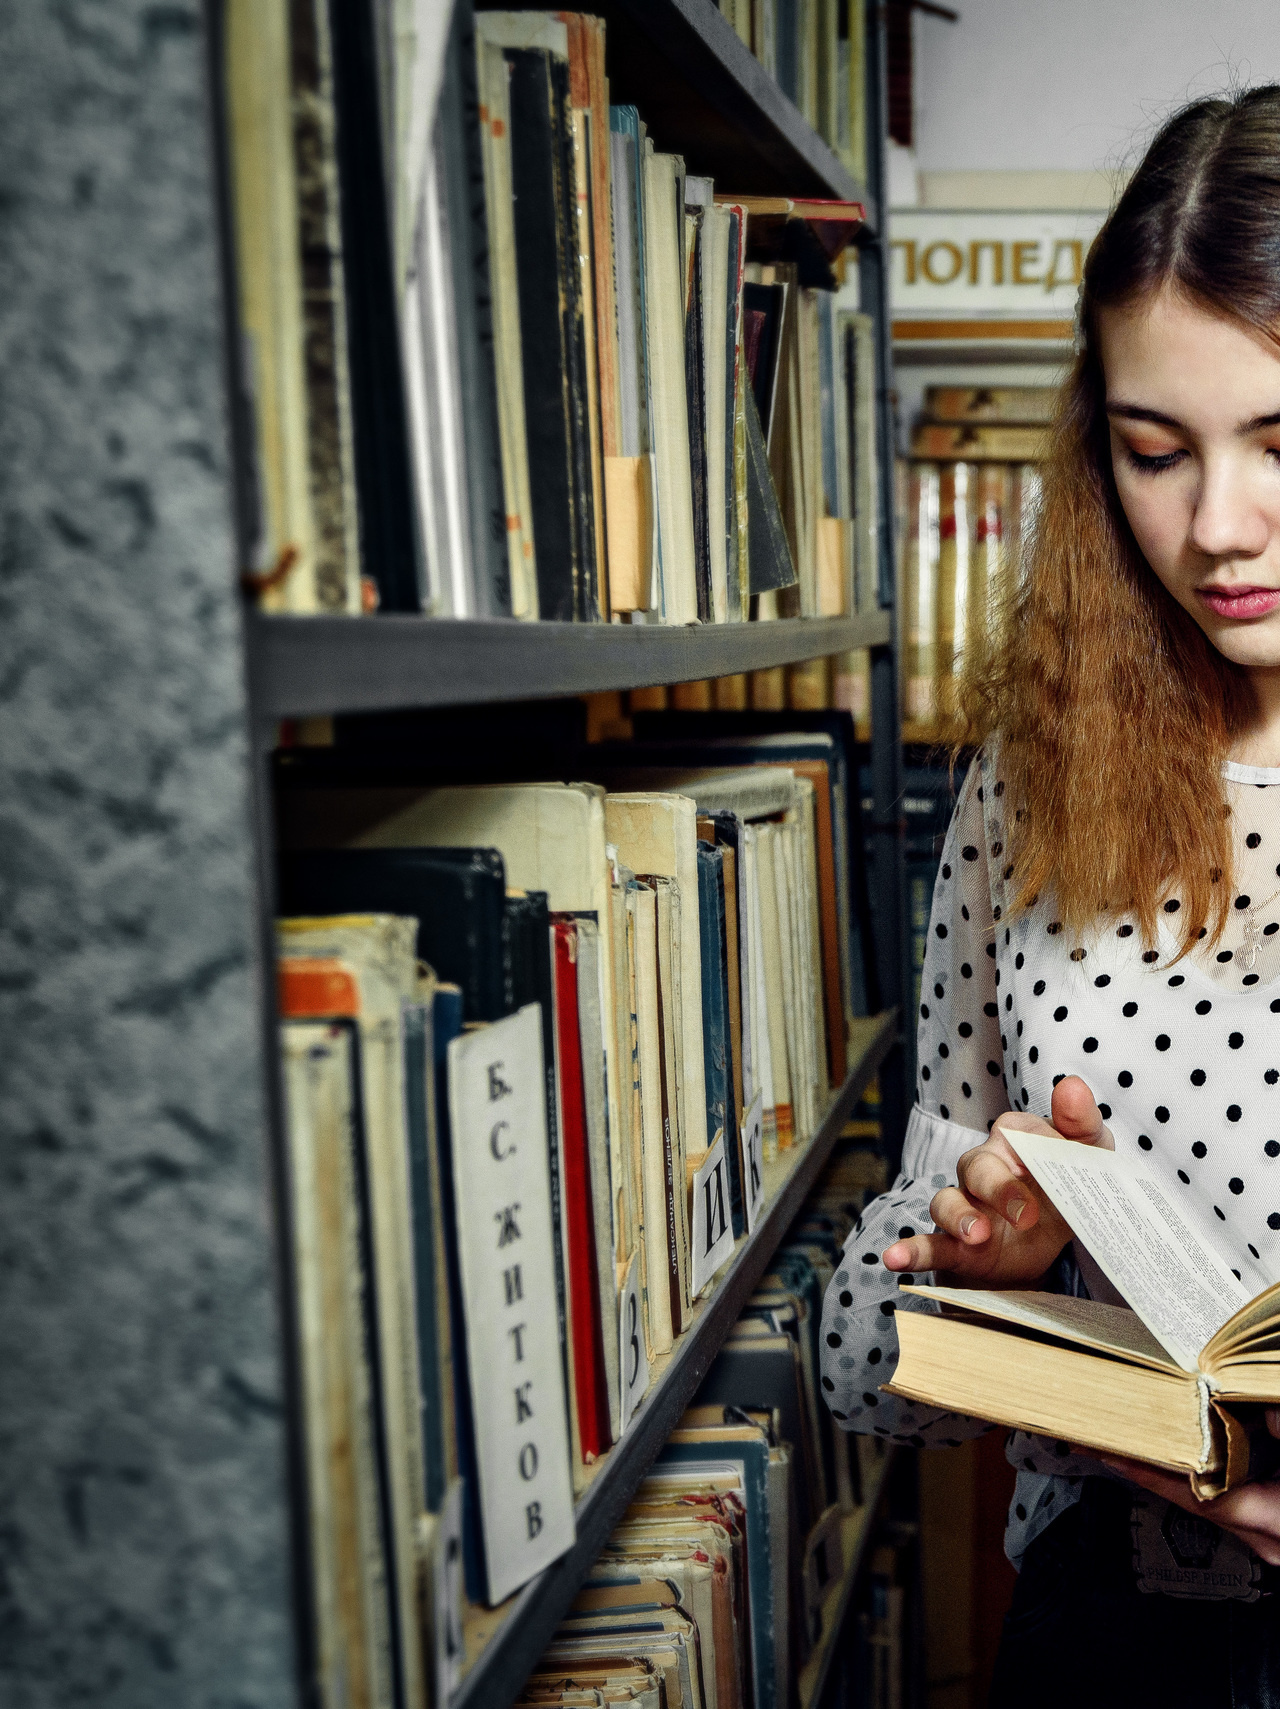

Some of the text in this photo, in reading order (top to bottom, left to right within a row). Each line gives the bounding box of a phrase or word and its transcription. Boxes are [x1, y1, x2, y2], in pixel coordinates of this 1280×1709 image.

[486, 1060, 513, 1101] Б.
[490, 1120, 517, 1162] С.
[703, 1157, 728, 1258] И
[494, 1203, 544, 1542] ЖИТКОВ
